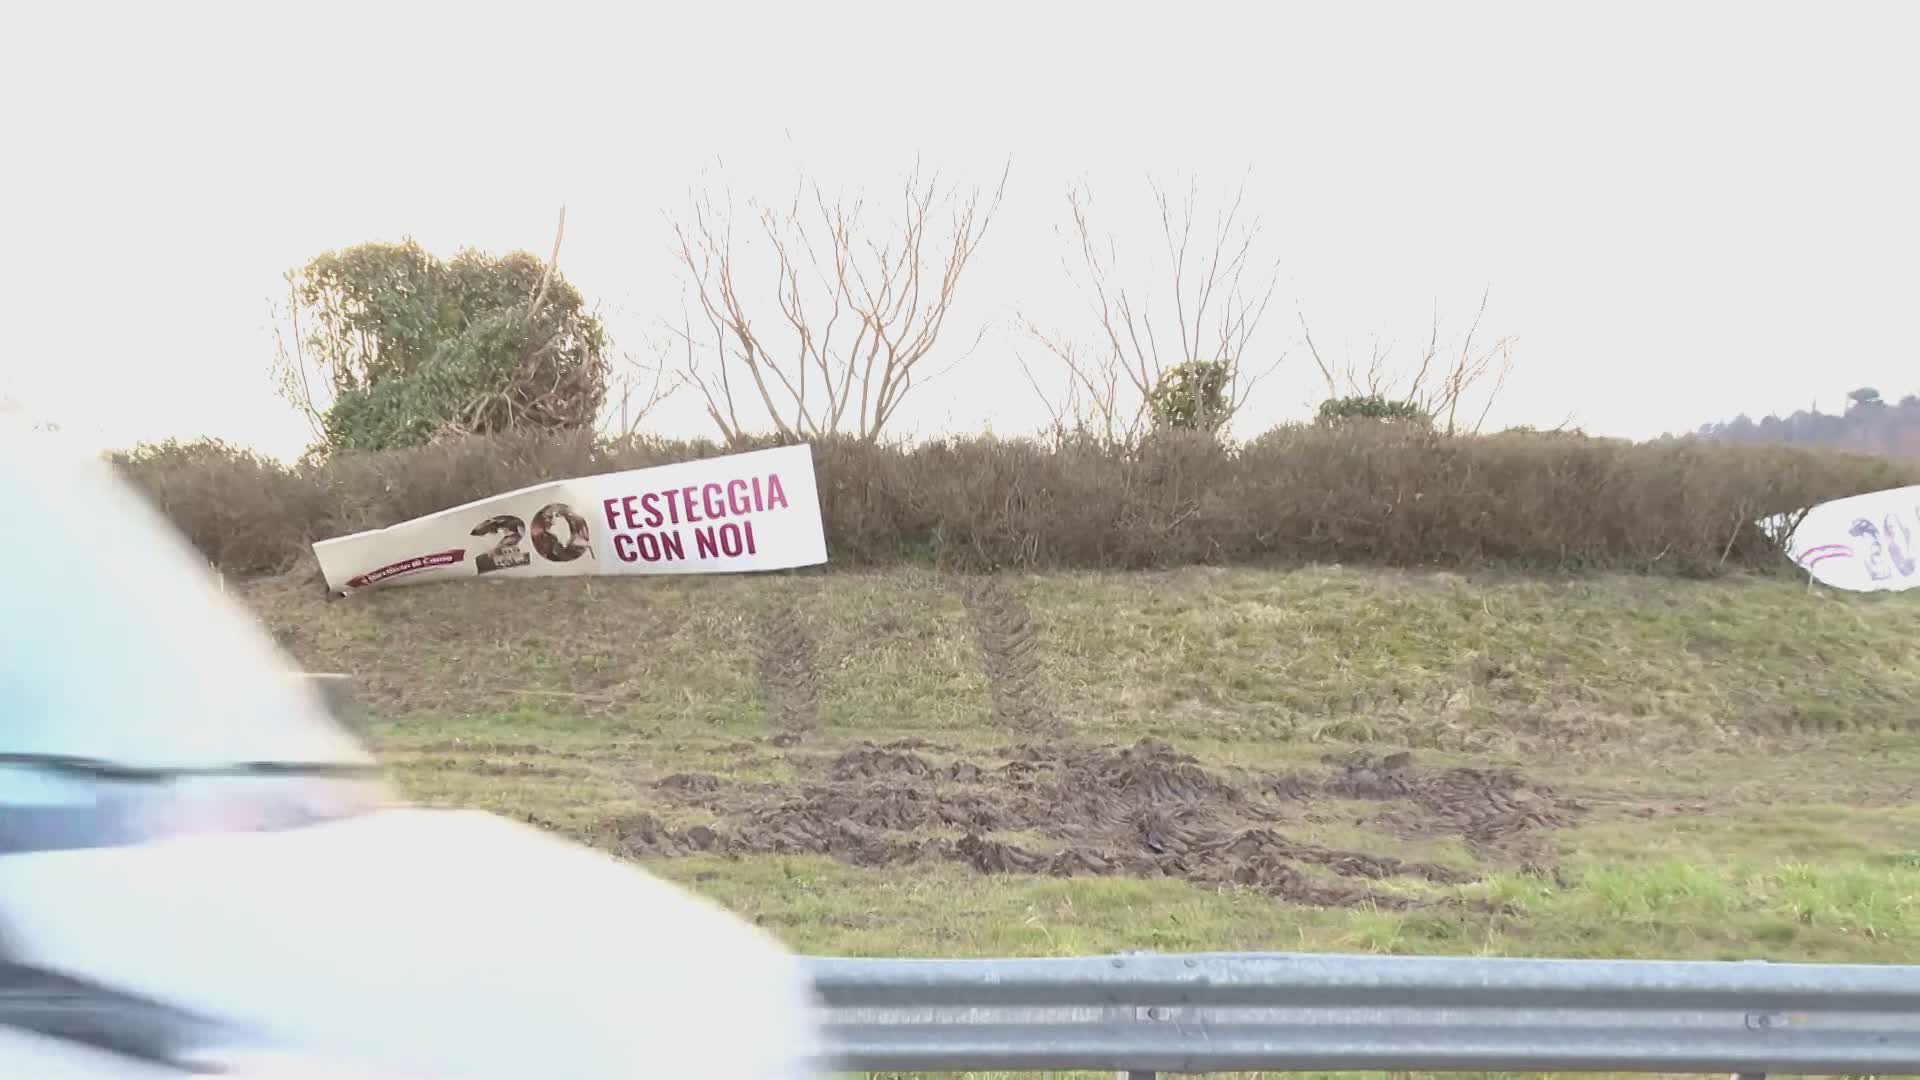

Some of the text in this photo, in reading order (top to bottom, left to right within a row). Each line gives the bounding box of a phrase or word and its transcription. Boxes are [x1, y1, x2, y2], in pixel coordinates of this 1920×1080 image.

[604, 473, 789, 530] FESTEGGIA
[470, 503, 595, 575] 20
[614, 521, 756, 562] CON NOI
